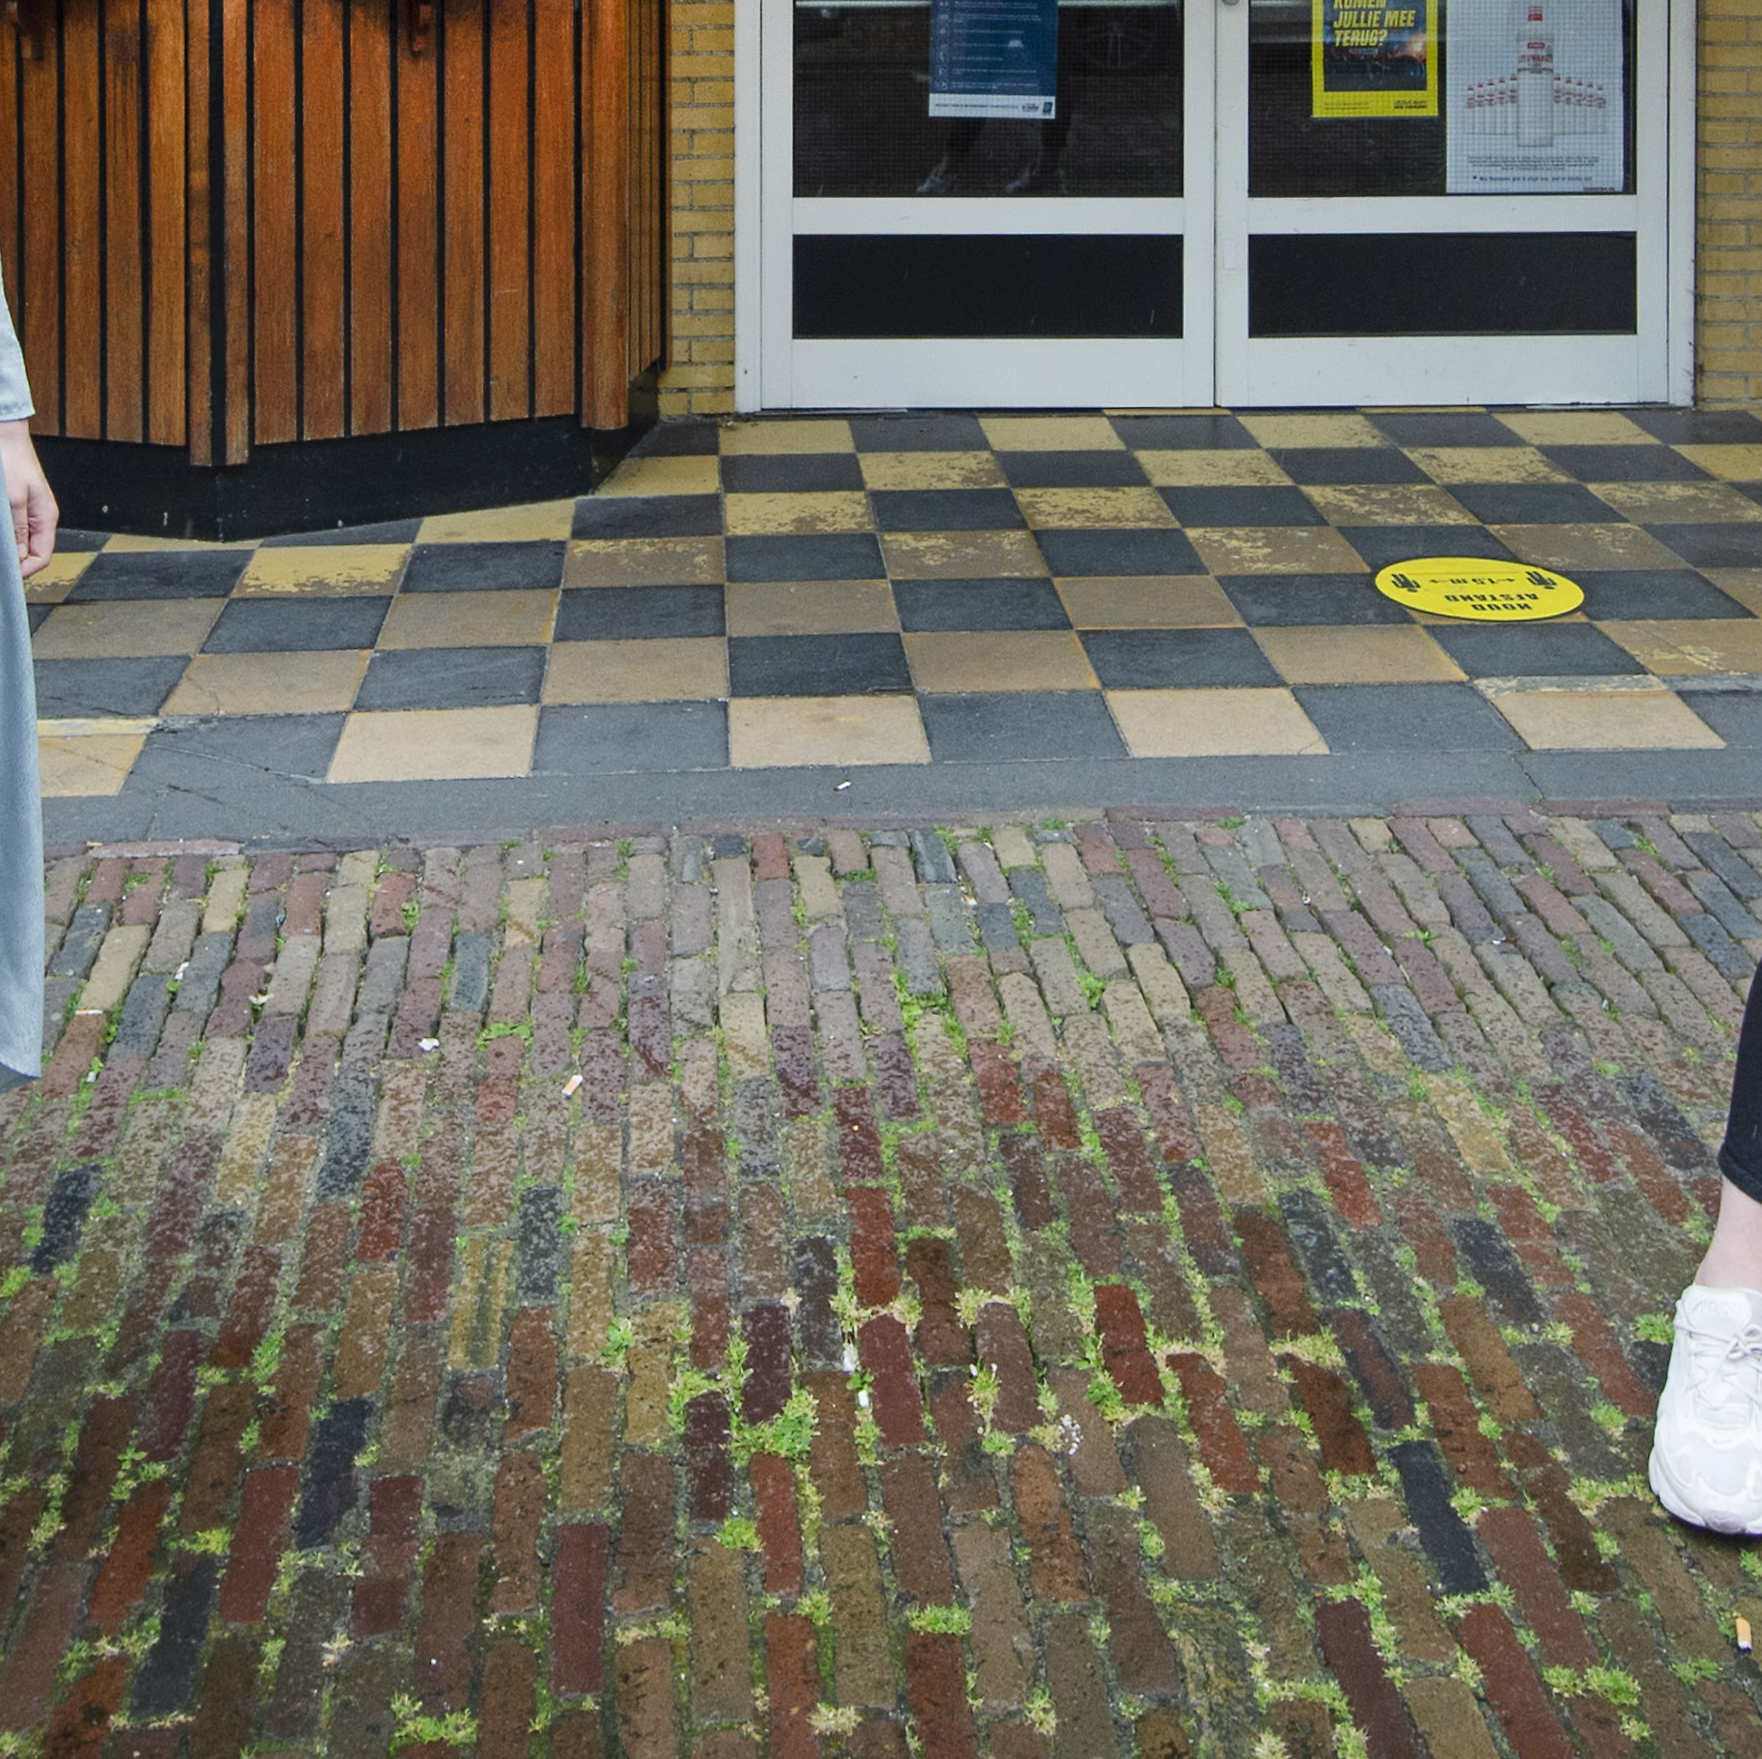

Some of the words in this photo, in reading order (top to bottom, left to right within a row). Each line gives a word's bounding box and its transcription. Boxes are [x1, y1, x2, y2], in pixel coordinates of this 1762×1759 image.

[1333, 10, 1382, 28] JULLIE
[1383, 10, 1416, 27] MEE
[1334, 29, 1389, 47] TERUG?
[1444, 593, 1539, 603] AFSTAND
[1470, 603, 1533, 612] HOUD
